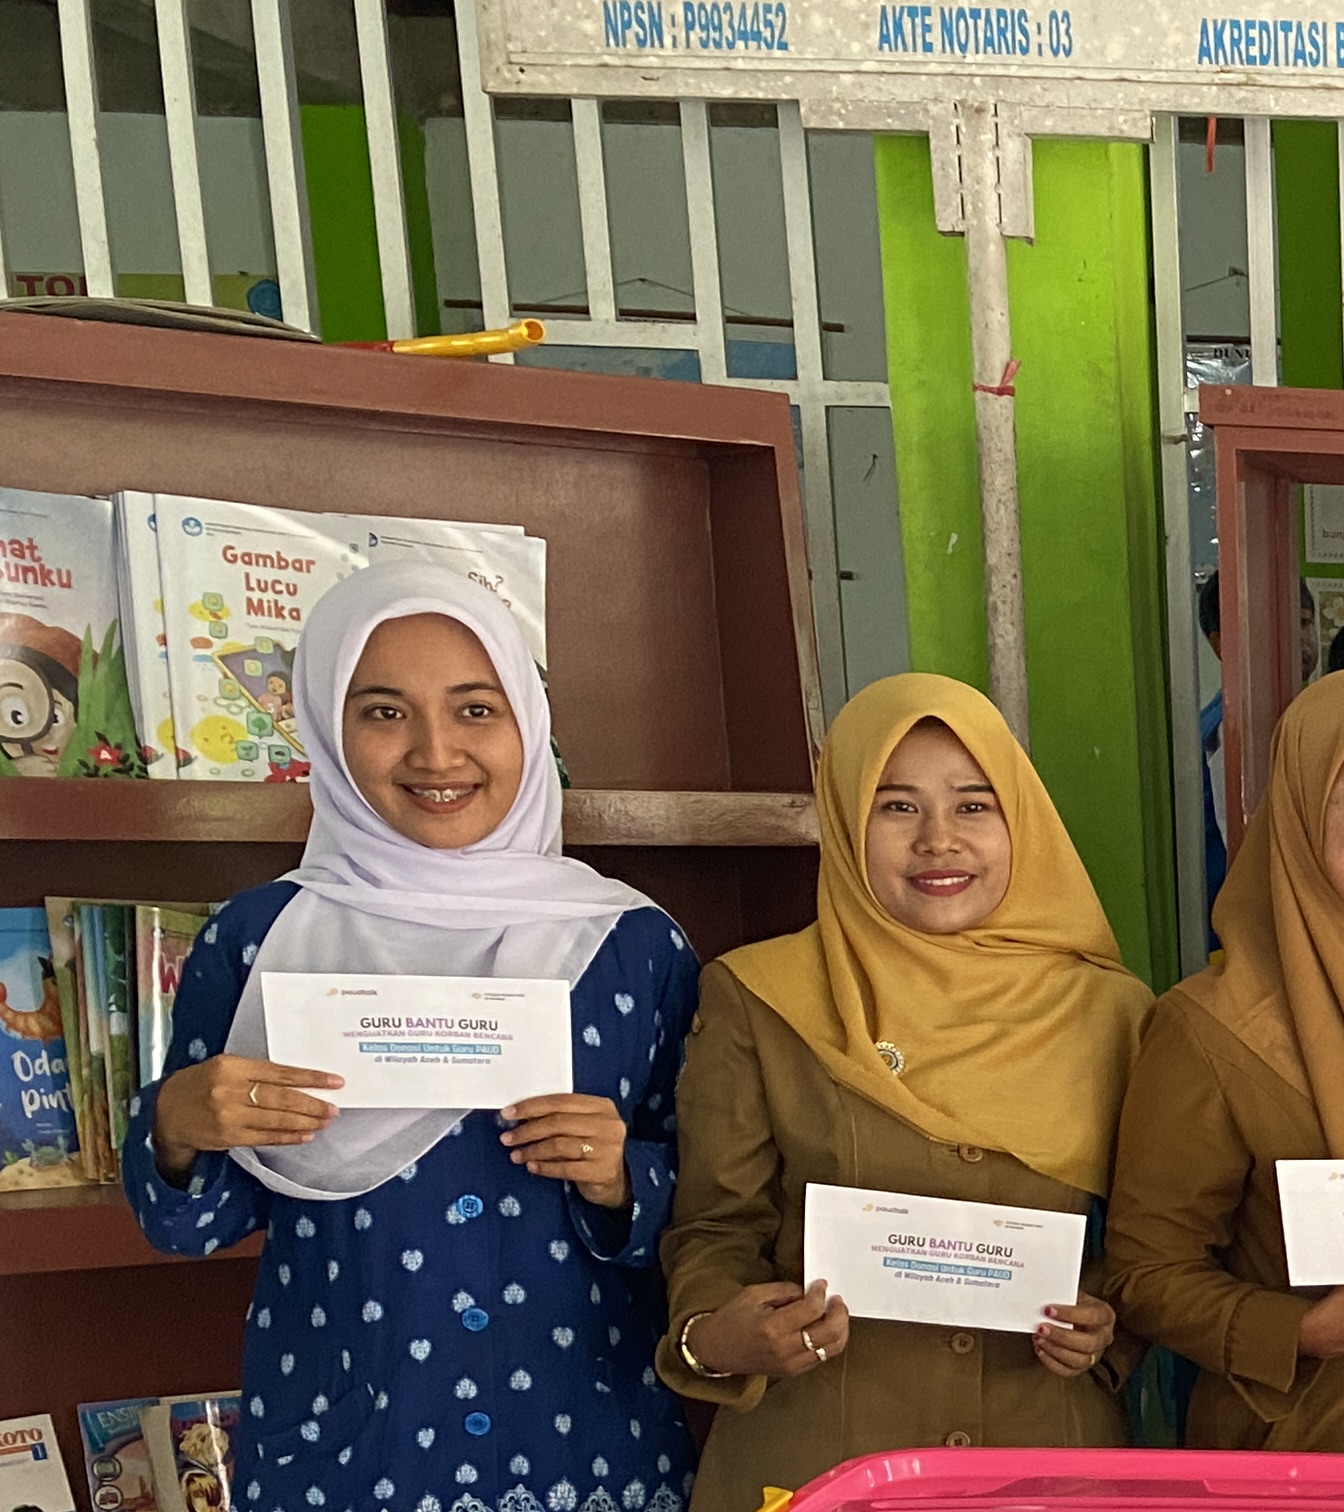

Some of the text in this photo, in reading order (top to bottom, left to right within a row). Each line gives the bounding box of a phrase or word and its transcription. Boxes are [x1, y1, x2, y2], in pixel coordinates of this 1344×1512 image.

[605, 2, 663, 49] NPSN
[684, 2, 789, 51] P9934452
[878, 6, 934, 53] AKTE
[940, 9, 1030, 56] NOTARIS
[1048, 15, 1073, 58] 03
[1198, 19, 1328, 68] AKREDITASI
[222, 544, 316, 574] Gambar
[0, 561, 72, 589] unku
[244, 571, 298, 596] Lucu
[246, 597, 302, 622] Mika
[360, 1018, 498, 1030] GURU BANTU GURU
[888, 1234, 1013, 1257] GURU BANTU GURU
